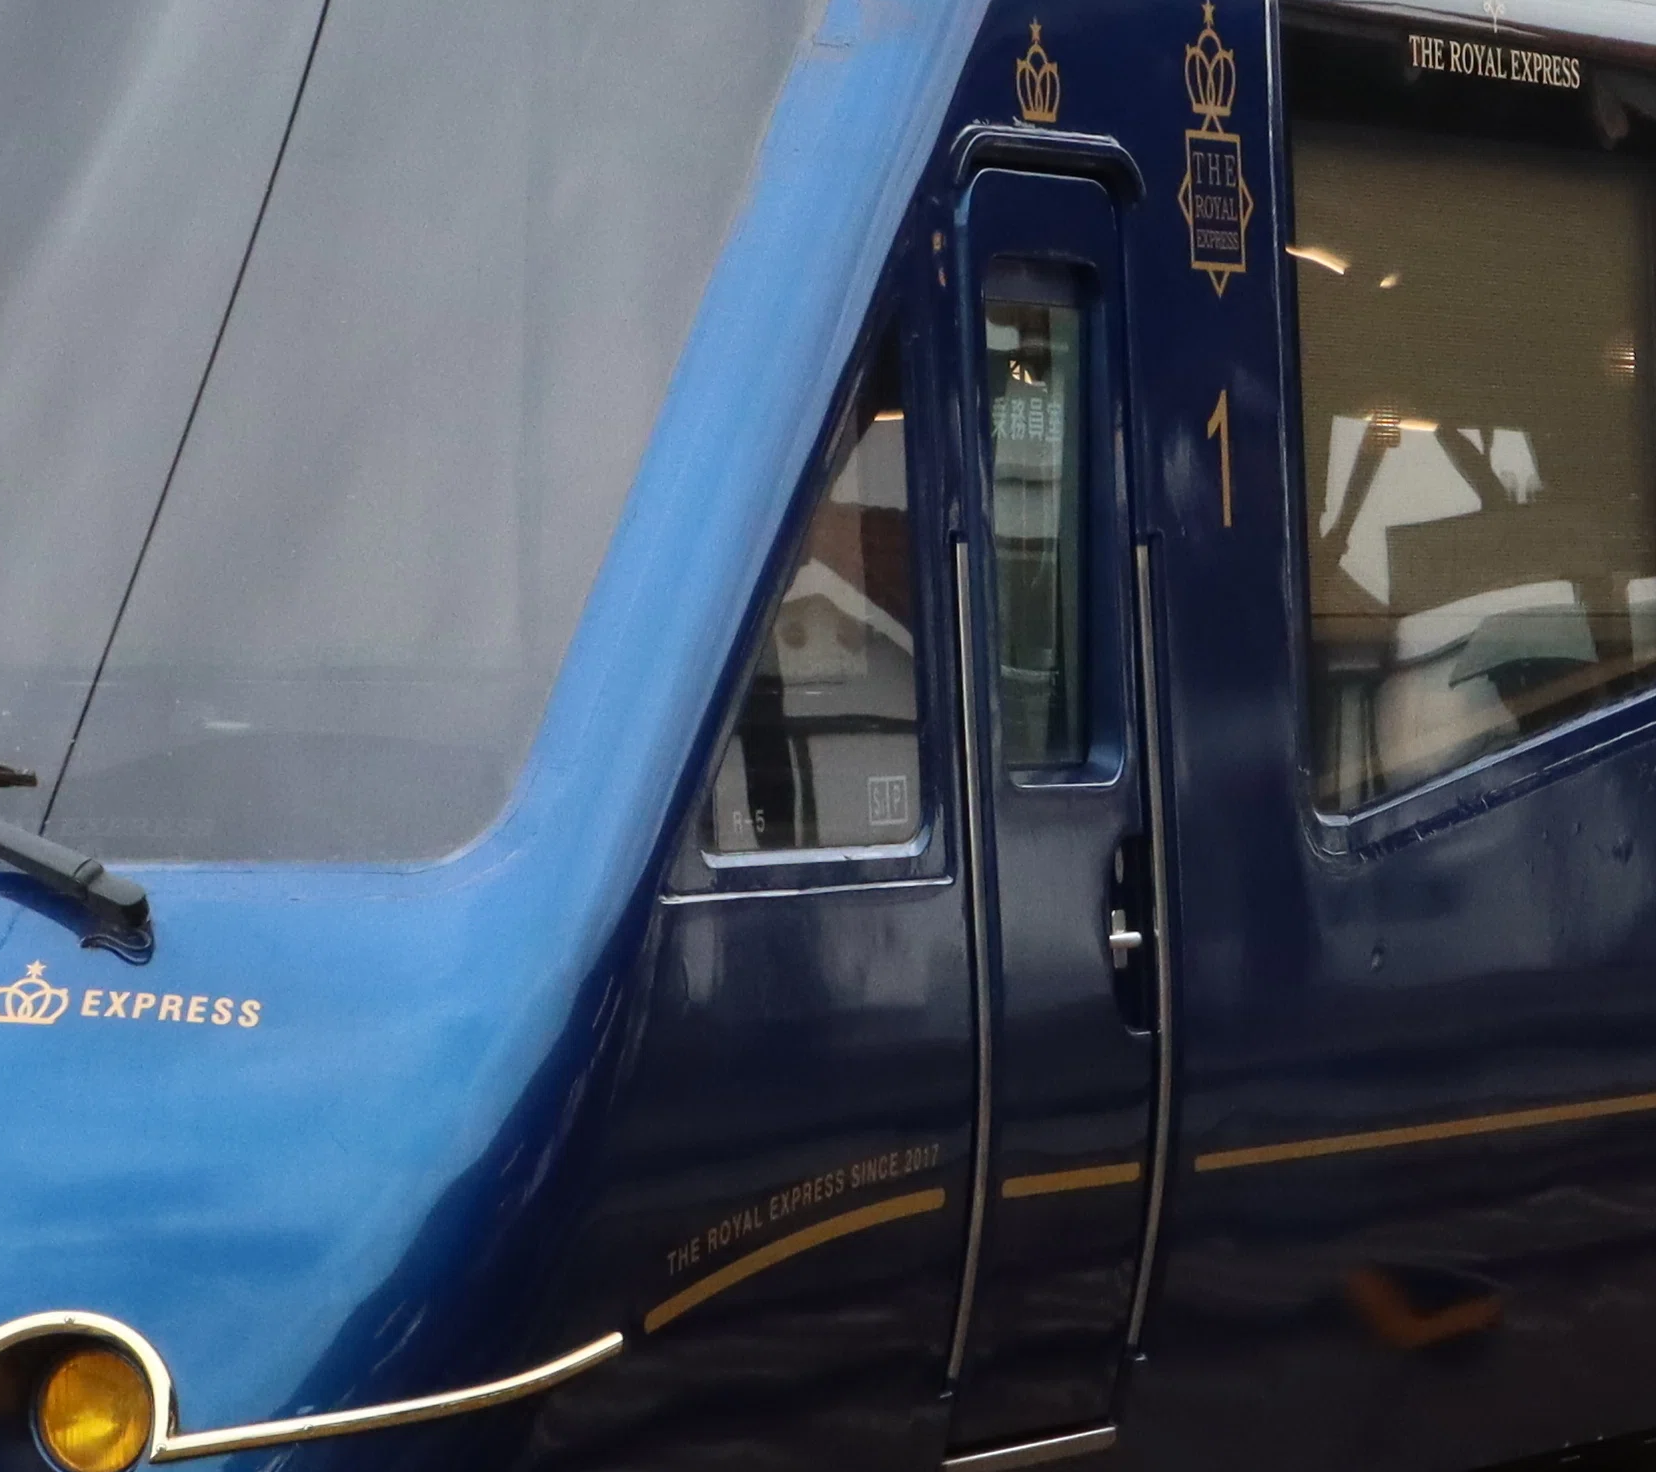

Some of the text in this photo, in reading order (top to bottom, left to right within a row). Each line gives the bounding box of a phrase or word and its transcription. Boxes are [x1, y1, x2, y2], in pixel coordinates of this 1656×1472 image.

[1409, 34, 1581, 89] THE ROYAL EXPRESS
[1192, 151, 1237, 188] THE
[1194, 194, 1239, 222] ROYAL
[1195, 228, 1240, 251] EXPRESS
[1207, 389, 1232, 528] 1
[79, 990, 263, 1028] EXPRESS
[666, 1143, 941, 1276] THE ROYAL EXPRESS SINCE 2017
